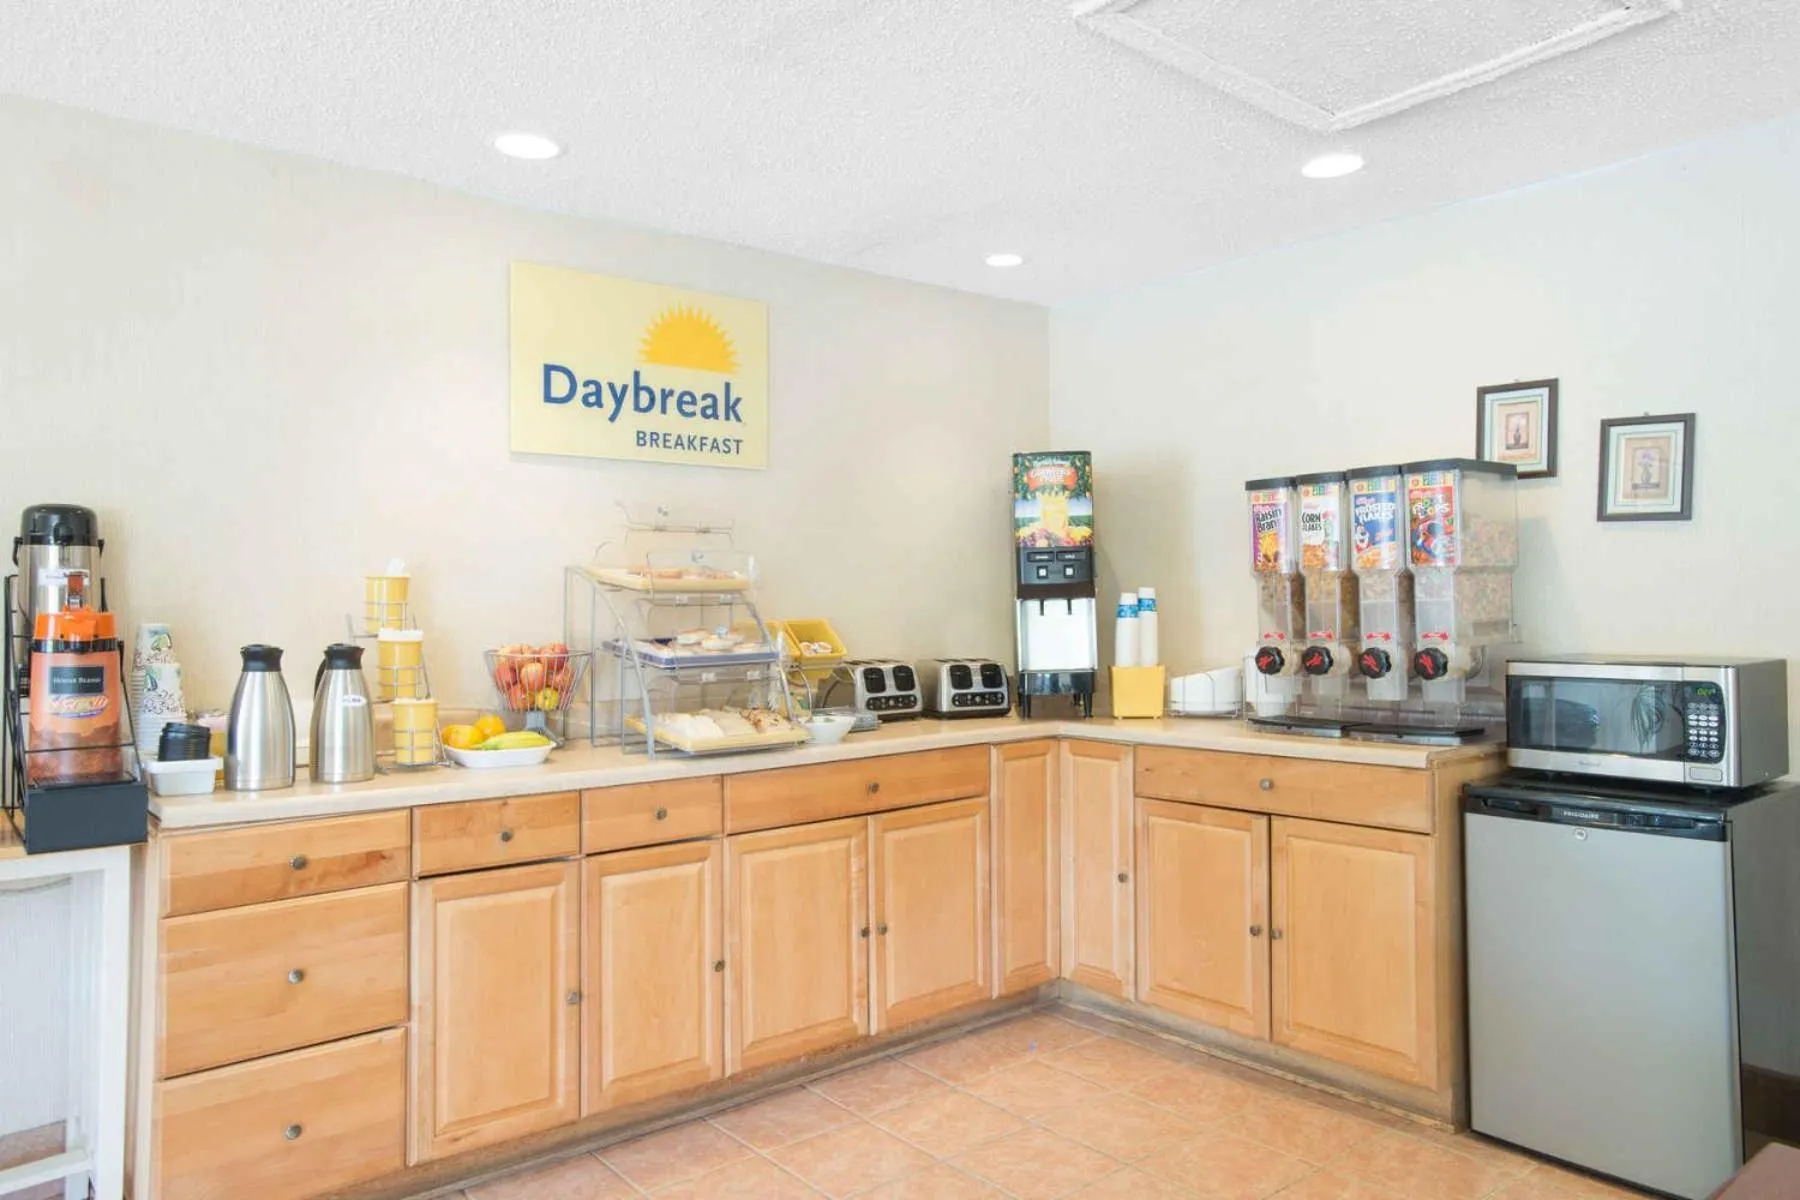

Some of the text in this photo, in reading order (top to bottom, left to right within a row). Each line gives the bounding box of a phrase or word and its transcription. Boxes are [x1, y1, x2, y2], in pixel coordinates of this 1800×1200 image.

[543, 363, 743, 423] Daybreak
[636, 430, 744, 456] BREAKFAST
[1255, 507, 1282, 522] Raisin
[1301, 512, 1321, 523] CORN
